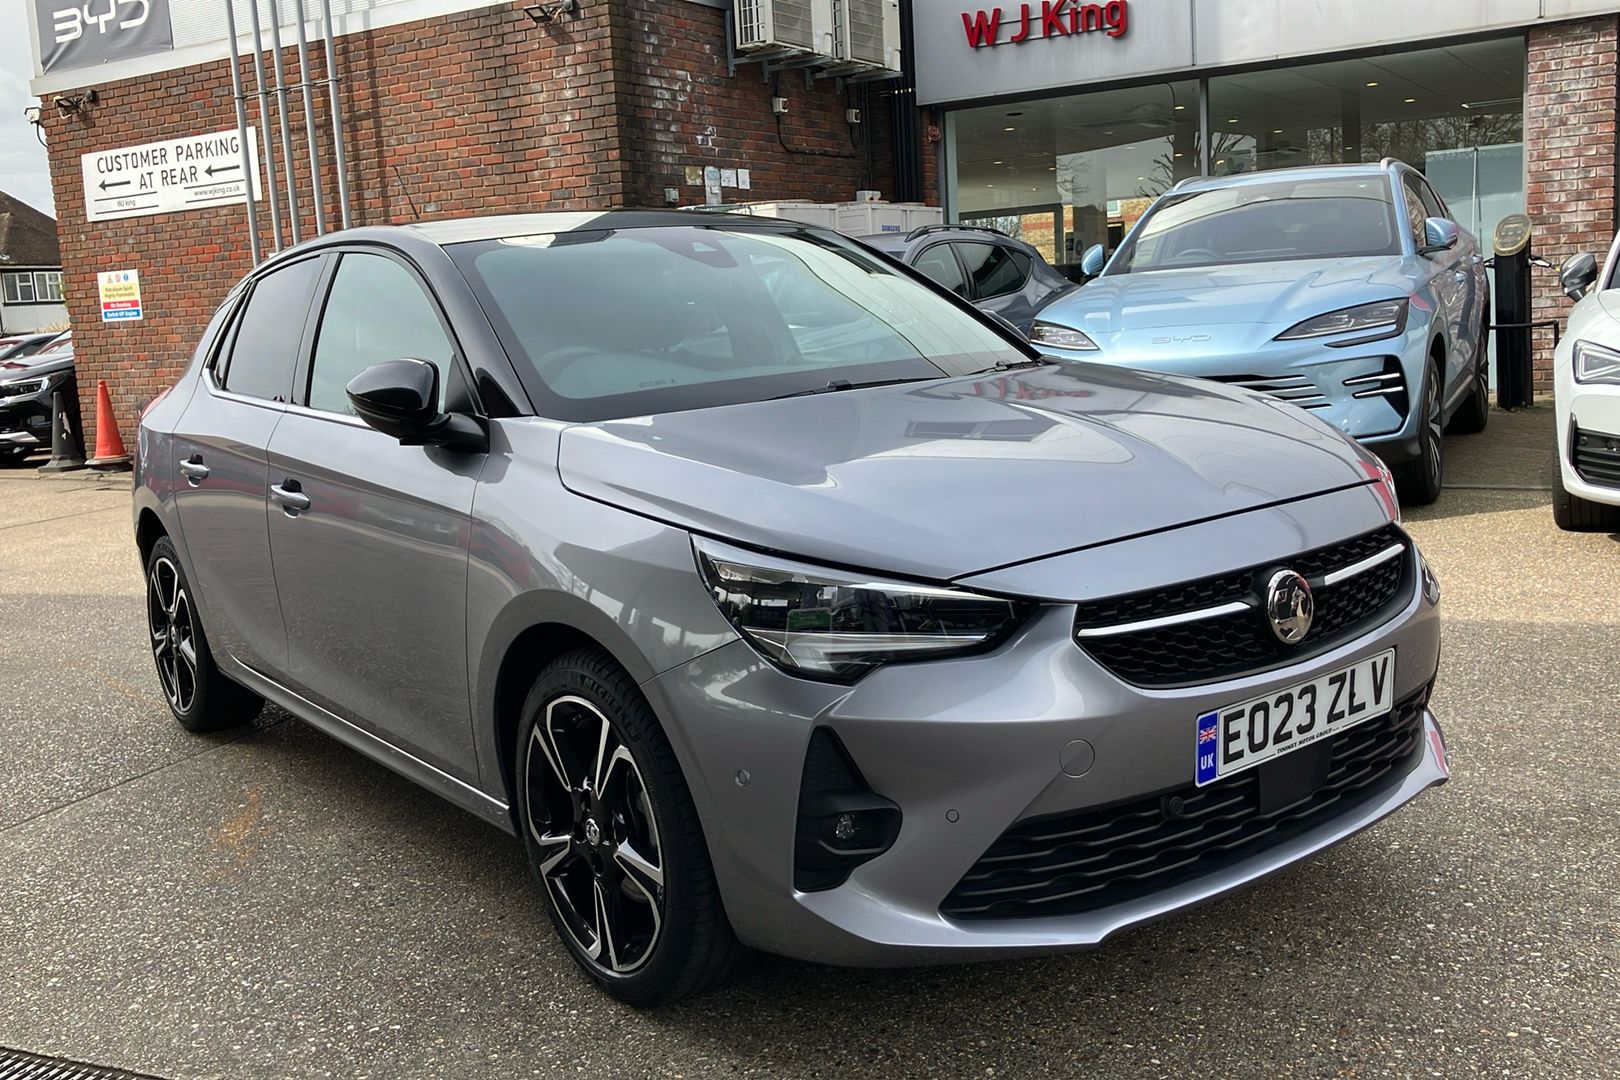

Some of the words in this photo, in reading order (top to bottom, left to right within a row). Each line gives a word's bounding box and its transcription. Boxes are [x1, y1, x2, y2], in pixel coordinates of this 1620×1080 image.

[53, 0, 149, 43] BYD
[961, 8, 1001, 48] W
[1010, 3, 1029, 43] J
[1042, 0, 1128, 38] King
[97, 147, 168, 174] CUSTOMER
[175, 136, 239, 162] PARKING
[139, 172, 154, 190] AT
[161, 165, 199, 187] REAR
[194, 185, 241, 197] www.wjking.co.uk
[1327, 657, 1388, 724] ZLV
[1298, 735, 1316, 746] MOTOR
[1316, 728, 1333, 738] GROUP
[1200, 753, 1214, 770] UK
